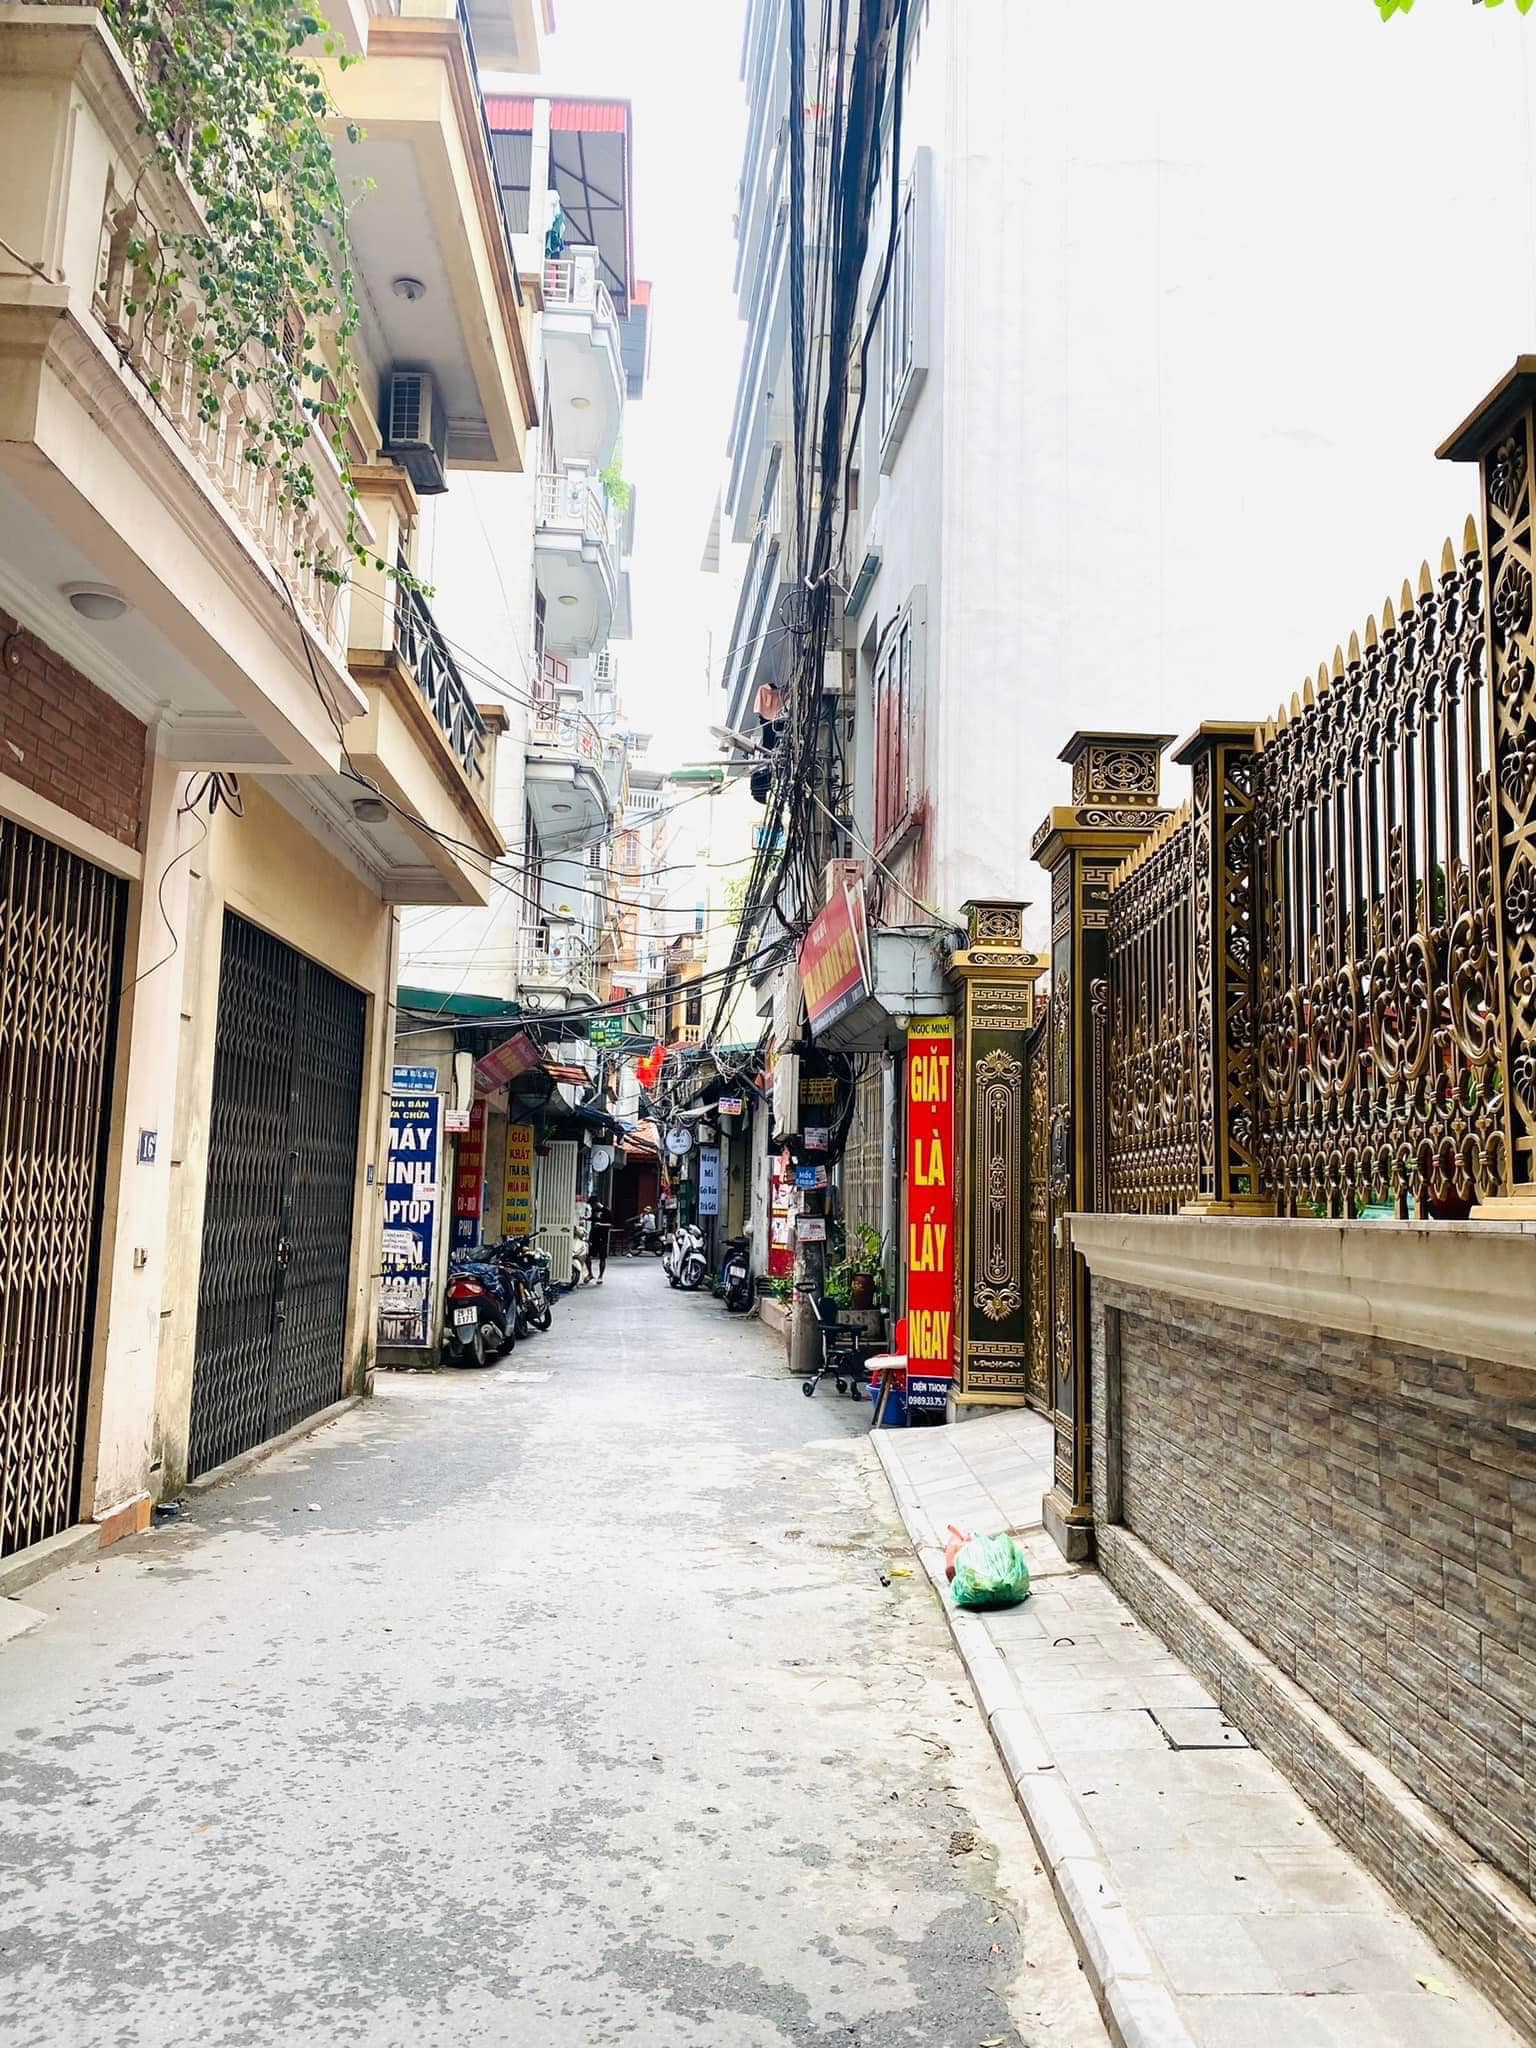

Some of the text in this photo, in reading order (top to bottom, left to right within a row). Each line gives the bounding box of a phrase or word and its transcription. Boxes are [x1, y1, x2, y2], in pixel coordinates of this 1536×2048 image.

[911, 1023, 950, 1035] NGỌC MINH
[911, 1045, 950, 1113] GIẶT
[391, 1100, 405, 1108] UA
[143, 1135, 156, 1158] 16
[914, 1127, 946, 1187] LÀ
[387, 1156, 432, 1185] ÍNH
[909, 1205, 947, 1273] LẤY
[909, 1309, 951, 1361] NGAY
